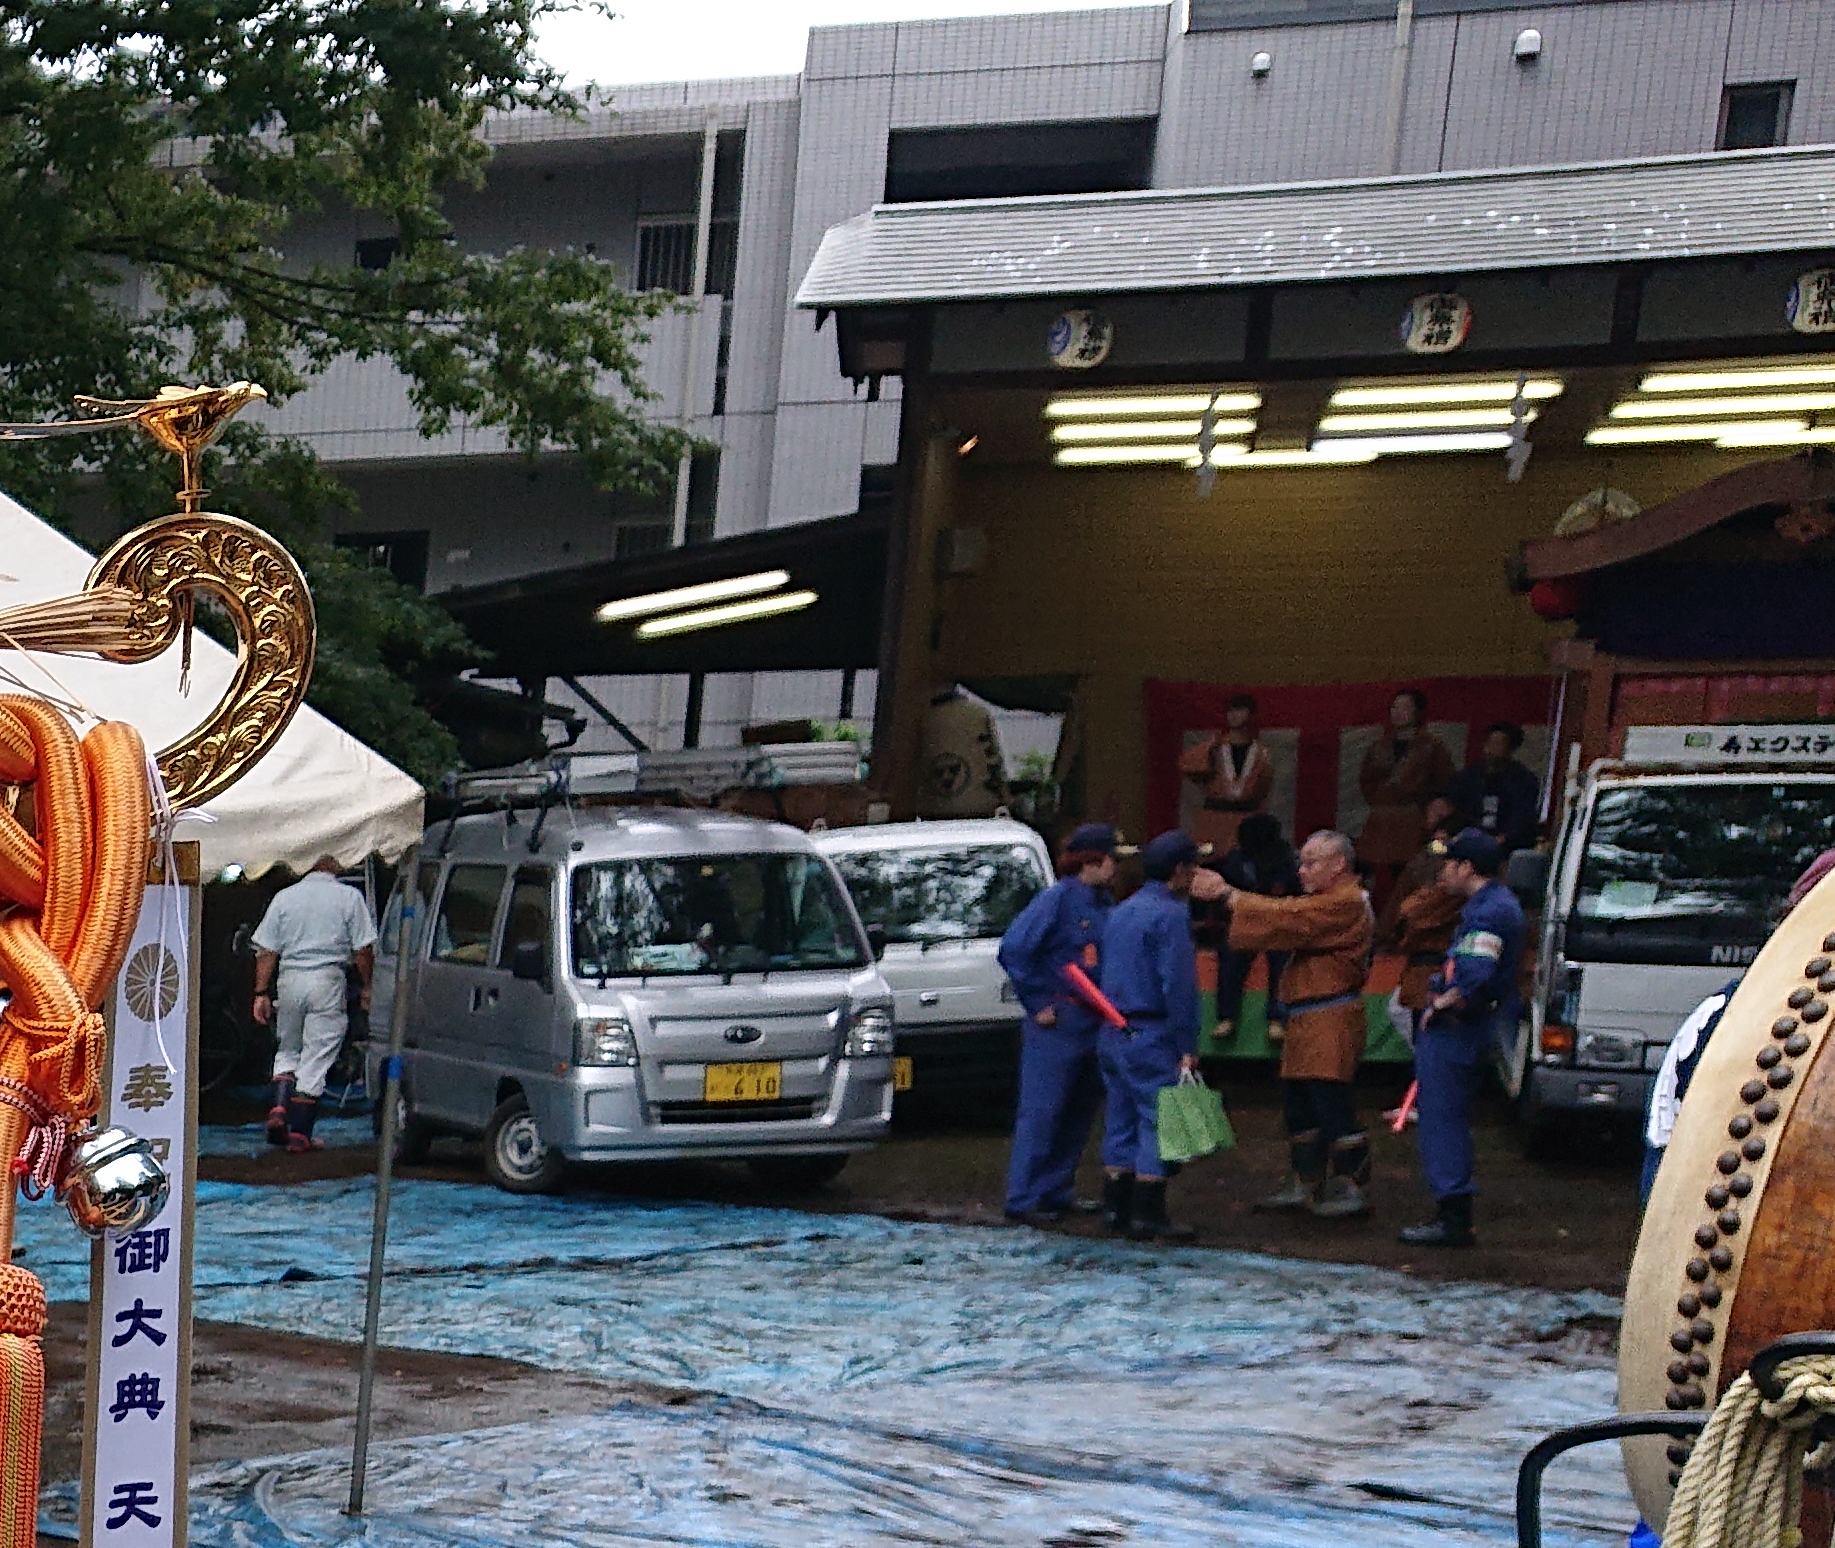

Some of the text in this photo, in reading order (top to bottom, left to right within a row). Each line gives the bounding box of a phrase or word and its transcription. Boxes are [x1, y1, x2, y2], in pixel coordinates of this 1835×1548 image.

[121, 1062, 174, 1172] 奉
[108, 1226, 171, 1422] 御大典
